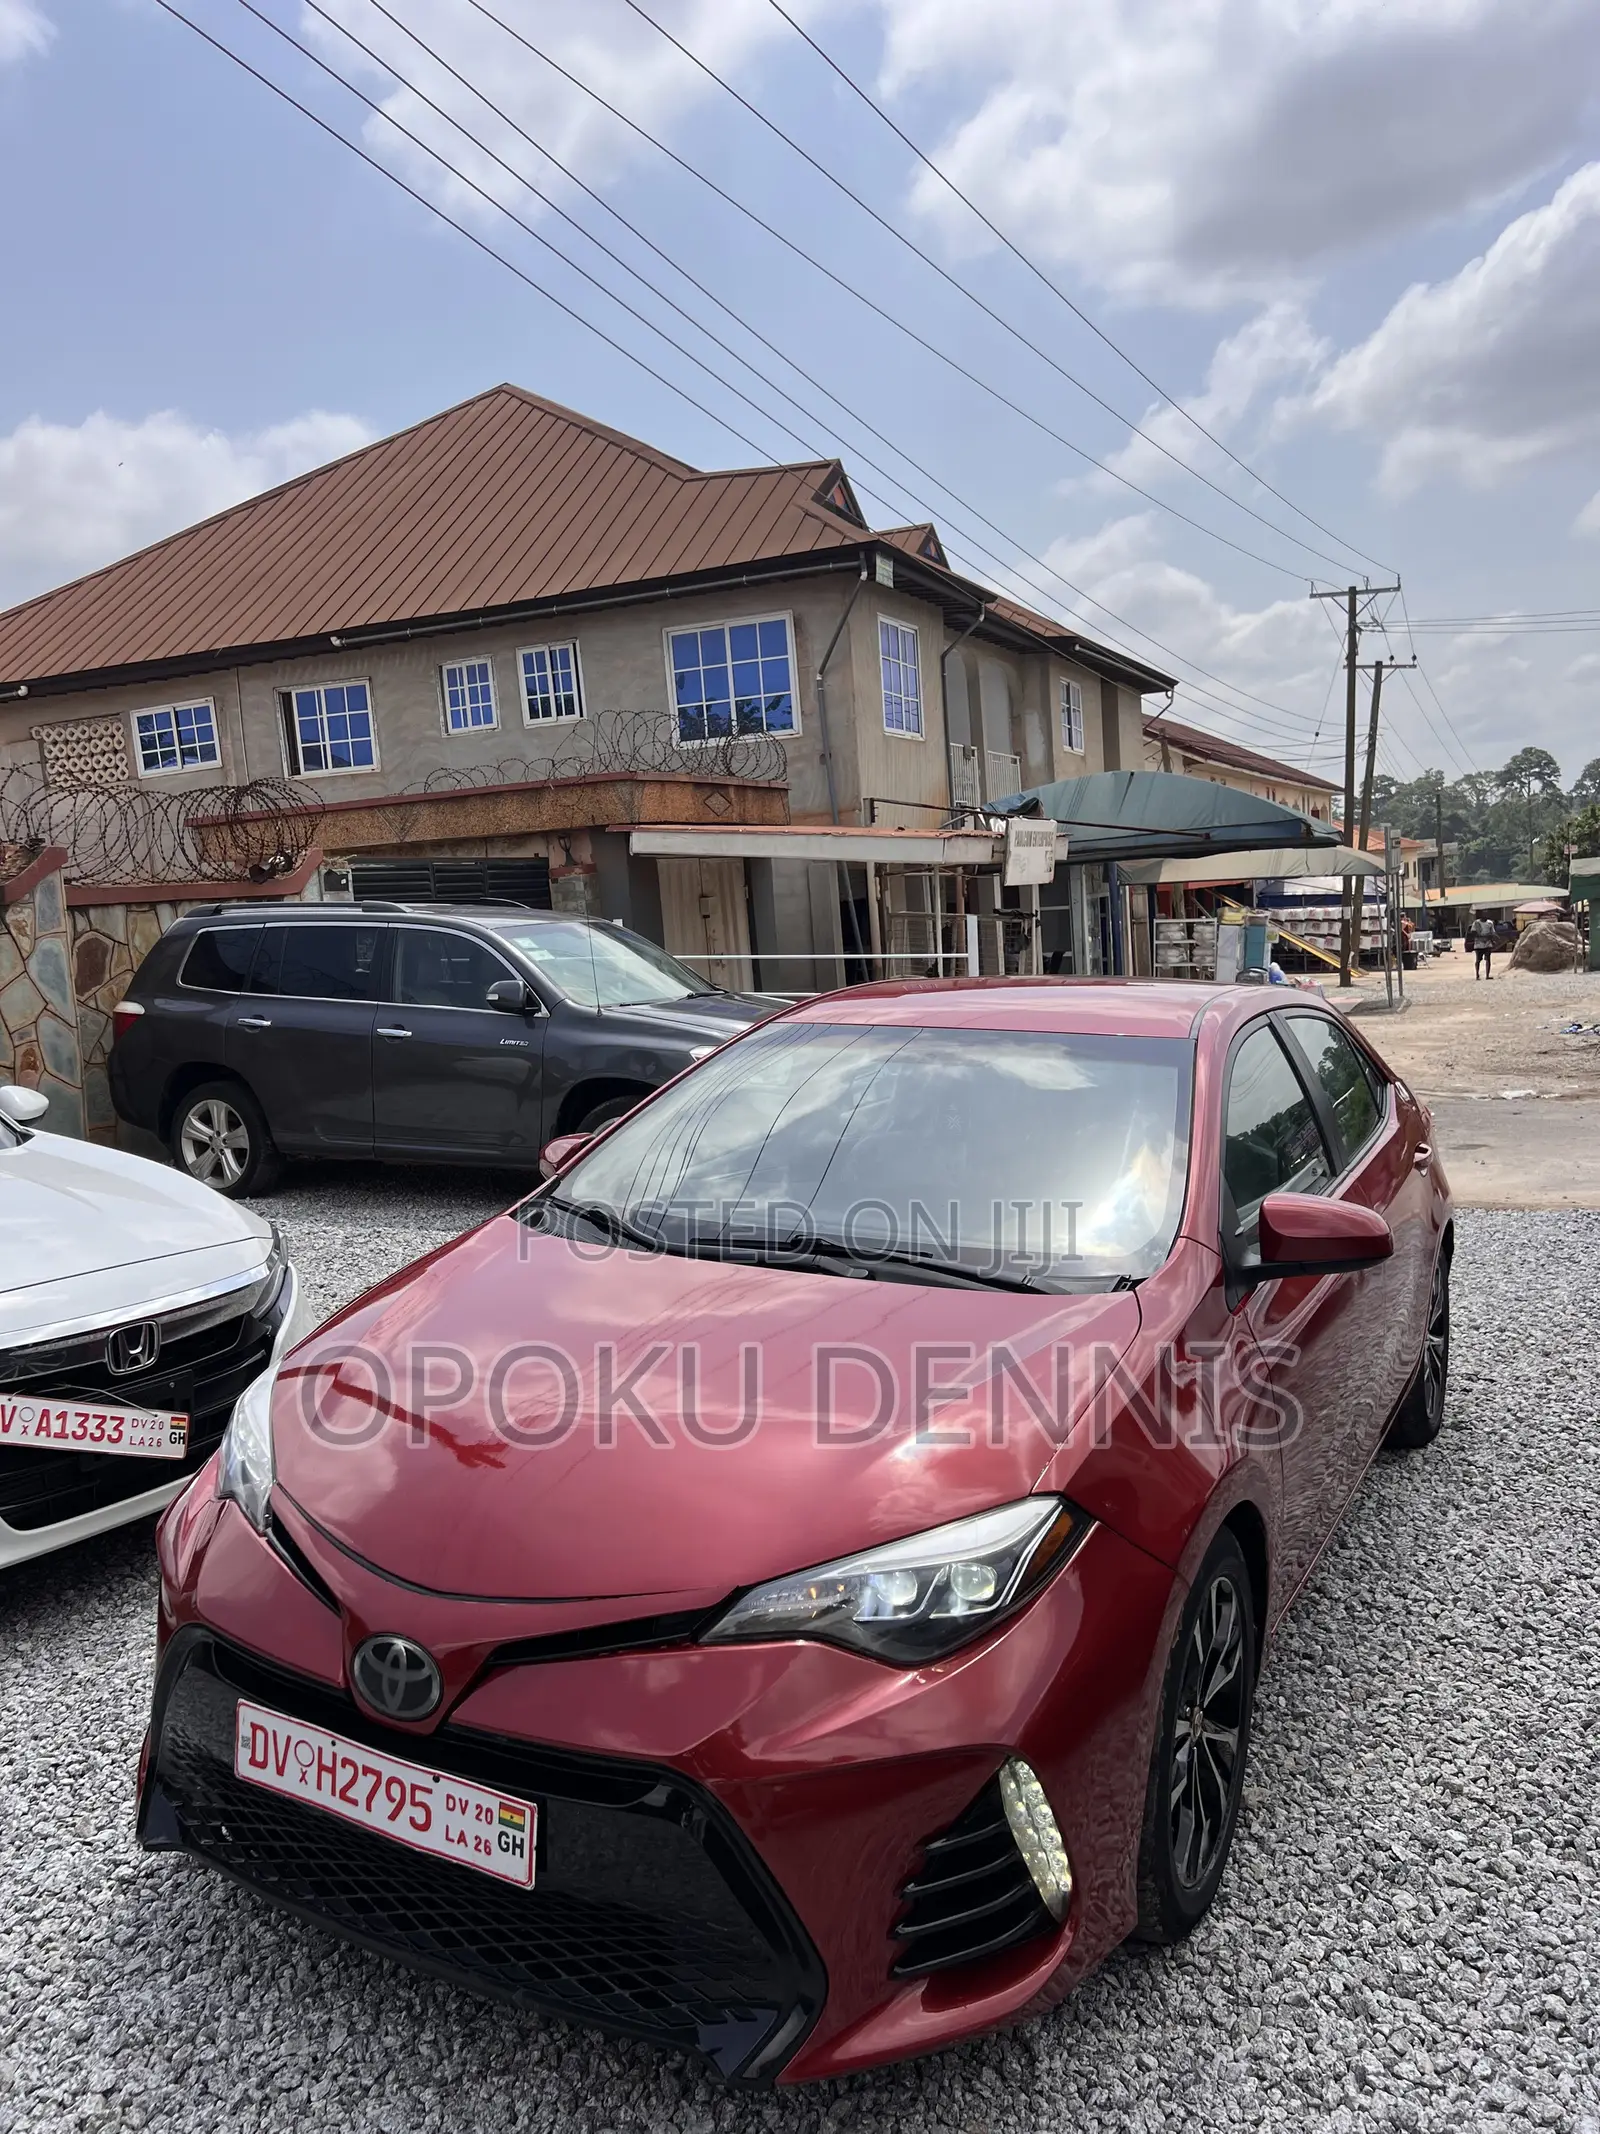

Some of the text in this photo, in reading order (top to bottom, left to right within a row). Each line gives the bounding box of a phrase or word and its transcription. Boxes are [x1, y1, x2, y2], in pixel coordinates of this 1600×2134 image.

[34, 1408, 125, 1444] A1333
[169, 1431, 185, 1445] GH
[249, 1721, 292, 1777] DV
[316, 1745, 433, 1832] H2795
[497, 1830, 525, 1859] GH
